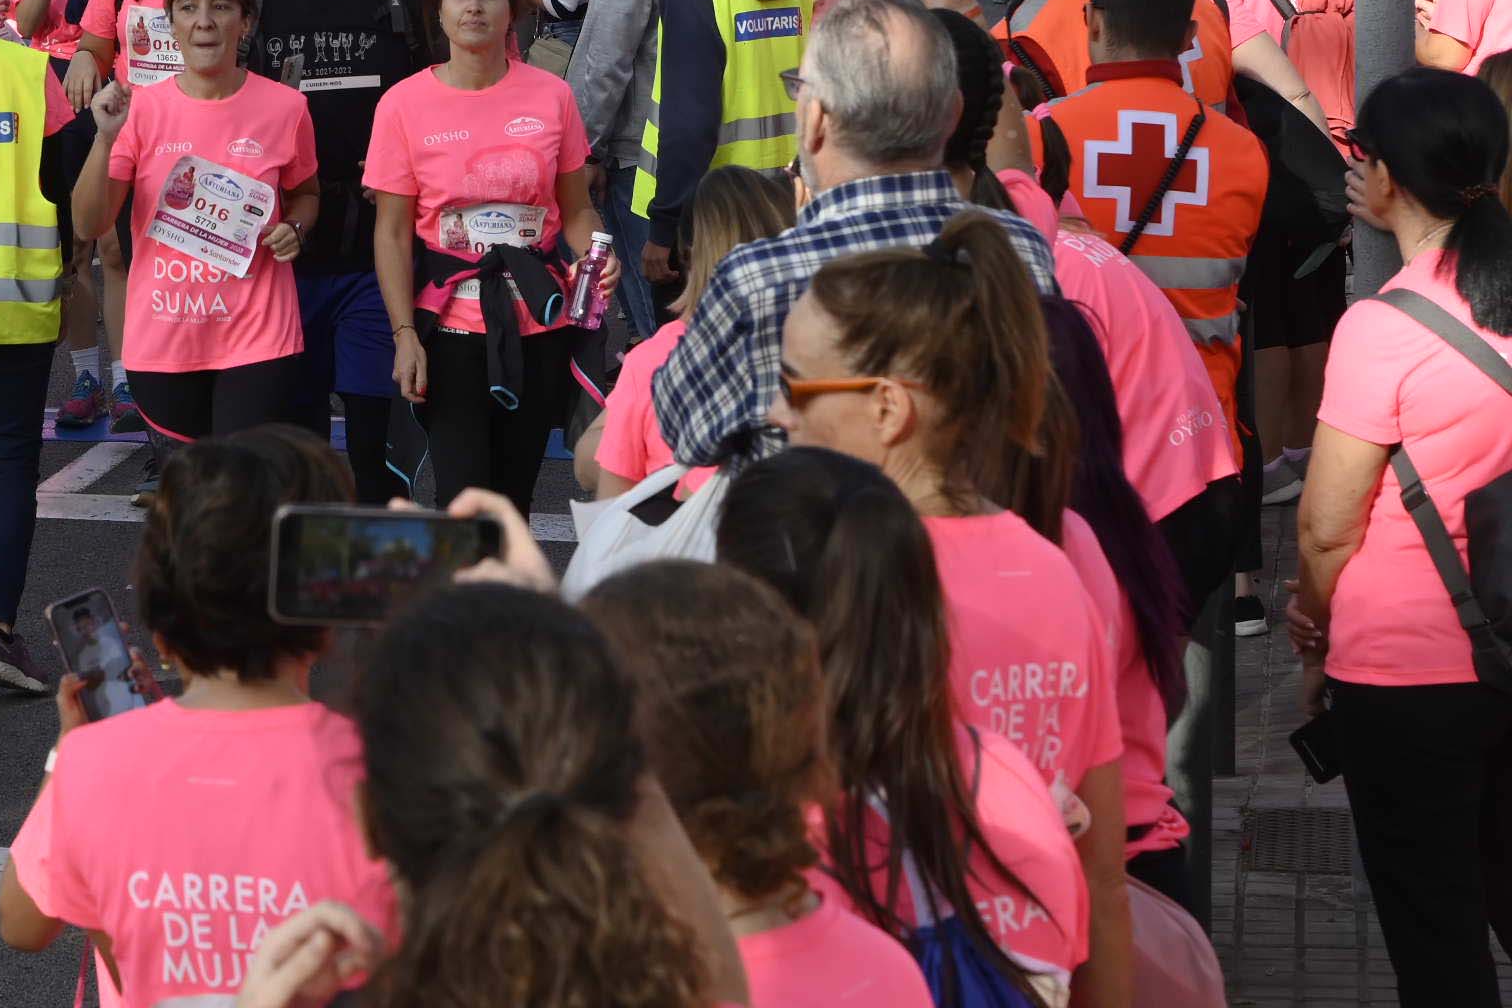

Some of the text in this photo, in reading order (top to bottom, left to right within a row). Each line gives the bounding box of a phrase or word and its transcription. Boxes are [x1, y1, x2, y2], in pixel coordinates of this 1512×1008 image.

[424, 130, 470, 146] OYSHO
[194, 197, 230, 222] 016
[153, 224, 185, 243] OYSHO
[161, 214, 190, 233] CARRERA
[189, 226, 199, 236] DE
[198, 230, 207, 241] LA
[207, 233, 228, 249] MUJER
[194, 215, 217, 231] 5779
[208, 249, 241, 267] Santander
[151, 289, 229, 315] SUMA
[127, 871, 310, 916] CARRERA
[162, 912, 211, 951] DE
